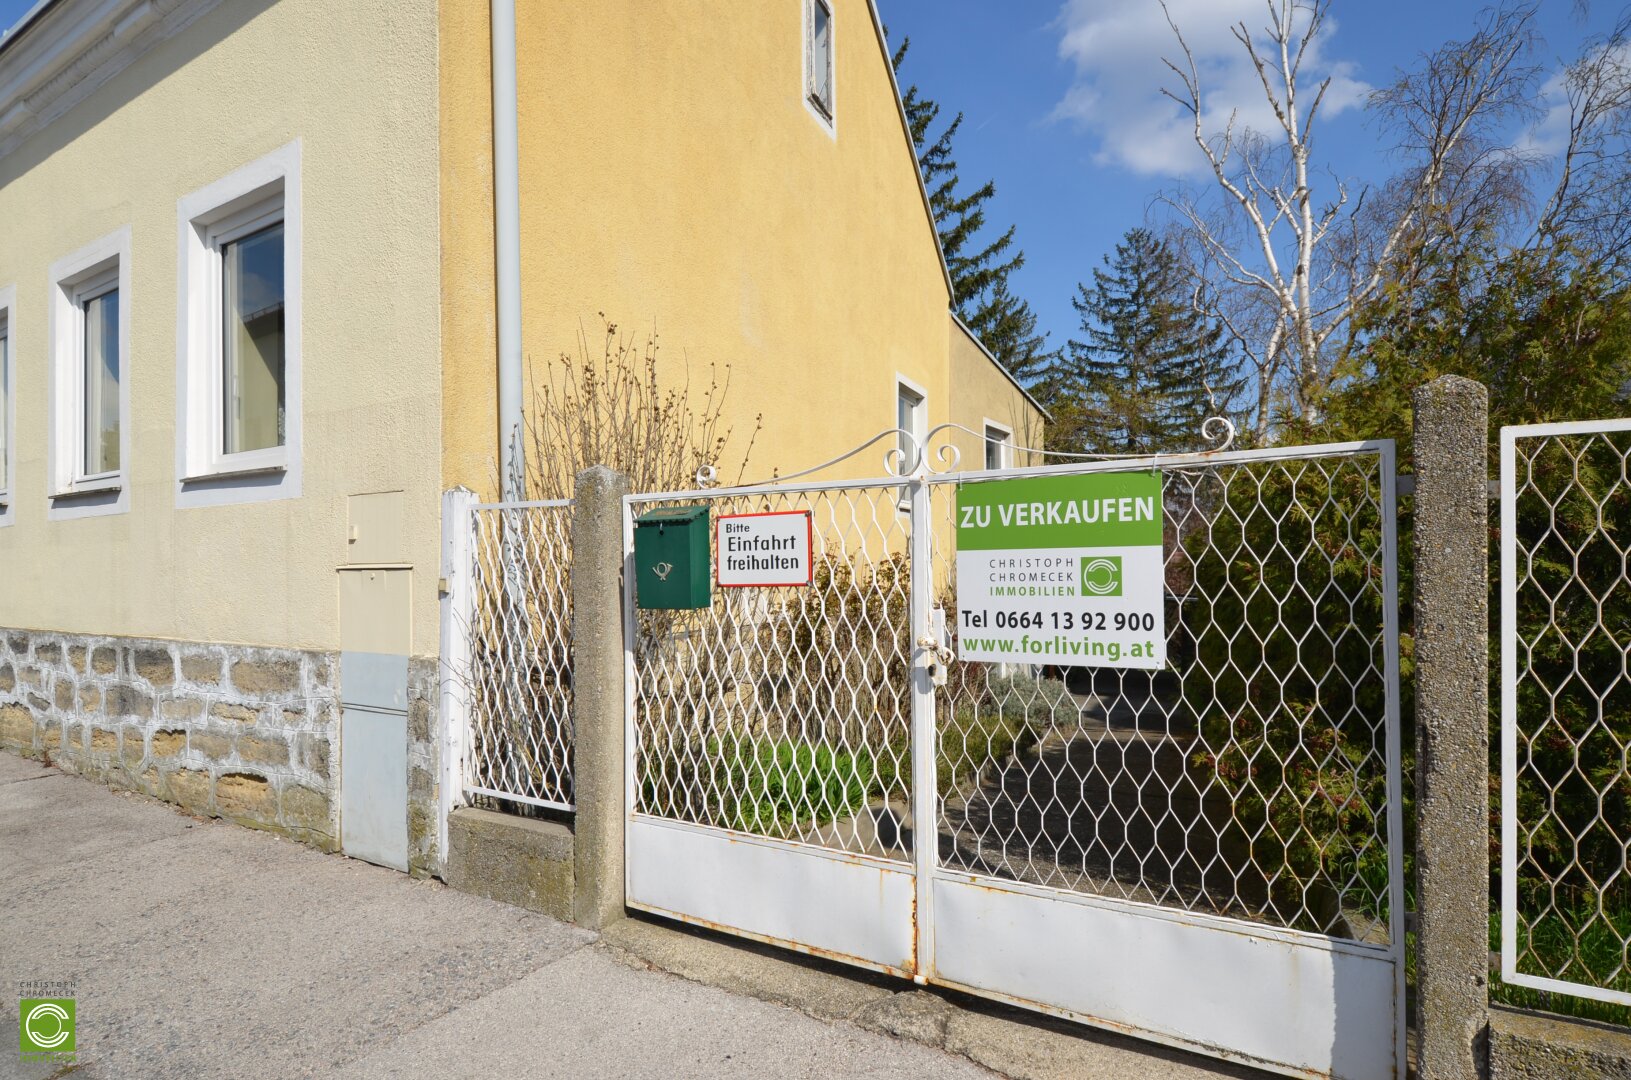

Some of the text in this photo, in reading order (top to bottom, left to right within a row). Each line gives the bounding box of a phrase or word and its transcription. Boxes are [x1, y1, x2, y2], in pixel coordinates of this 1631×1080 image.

[960, 496, 1154, 528] ZU VERKAUFEN
[725, 523, 750, 534] Bitte
[728, 535, 796, 552] Einfahrt
[727, 554, 799, 570] freihalten
[989, 558, 1074, 568] CHRISTOPH
[989, 572, 1074, 582] CHROMECEK
[990, 586, 1075, 596] IMMOBILIEN
[962, 610, 1155, 631] Tel 0664 13 92 900
[963, 635, 1155, 662] www.forliving.at
